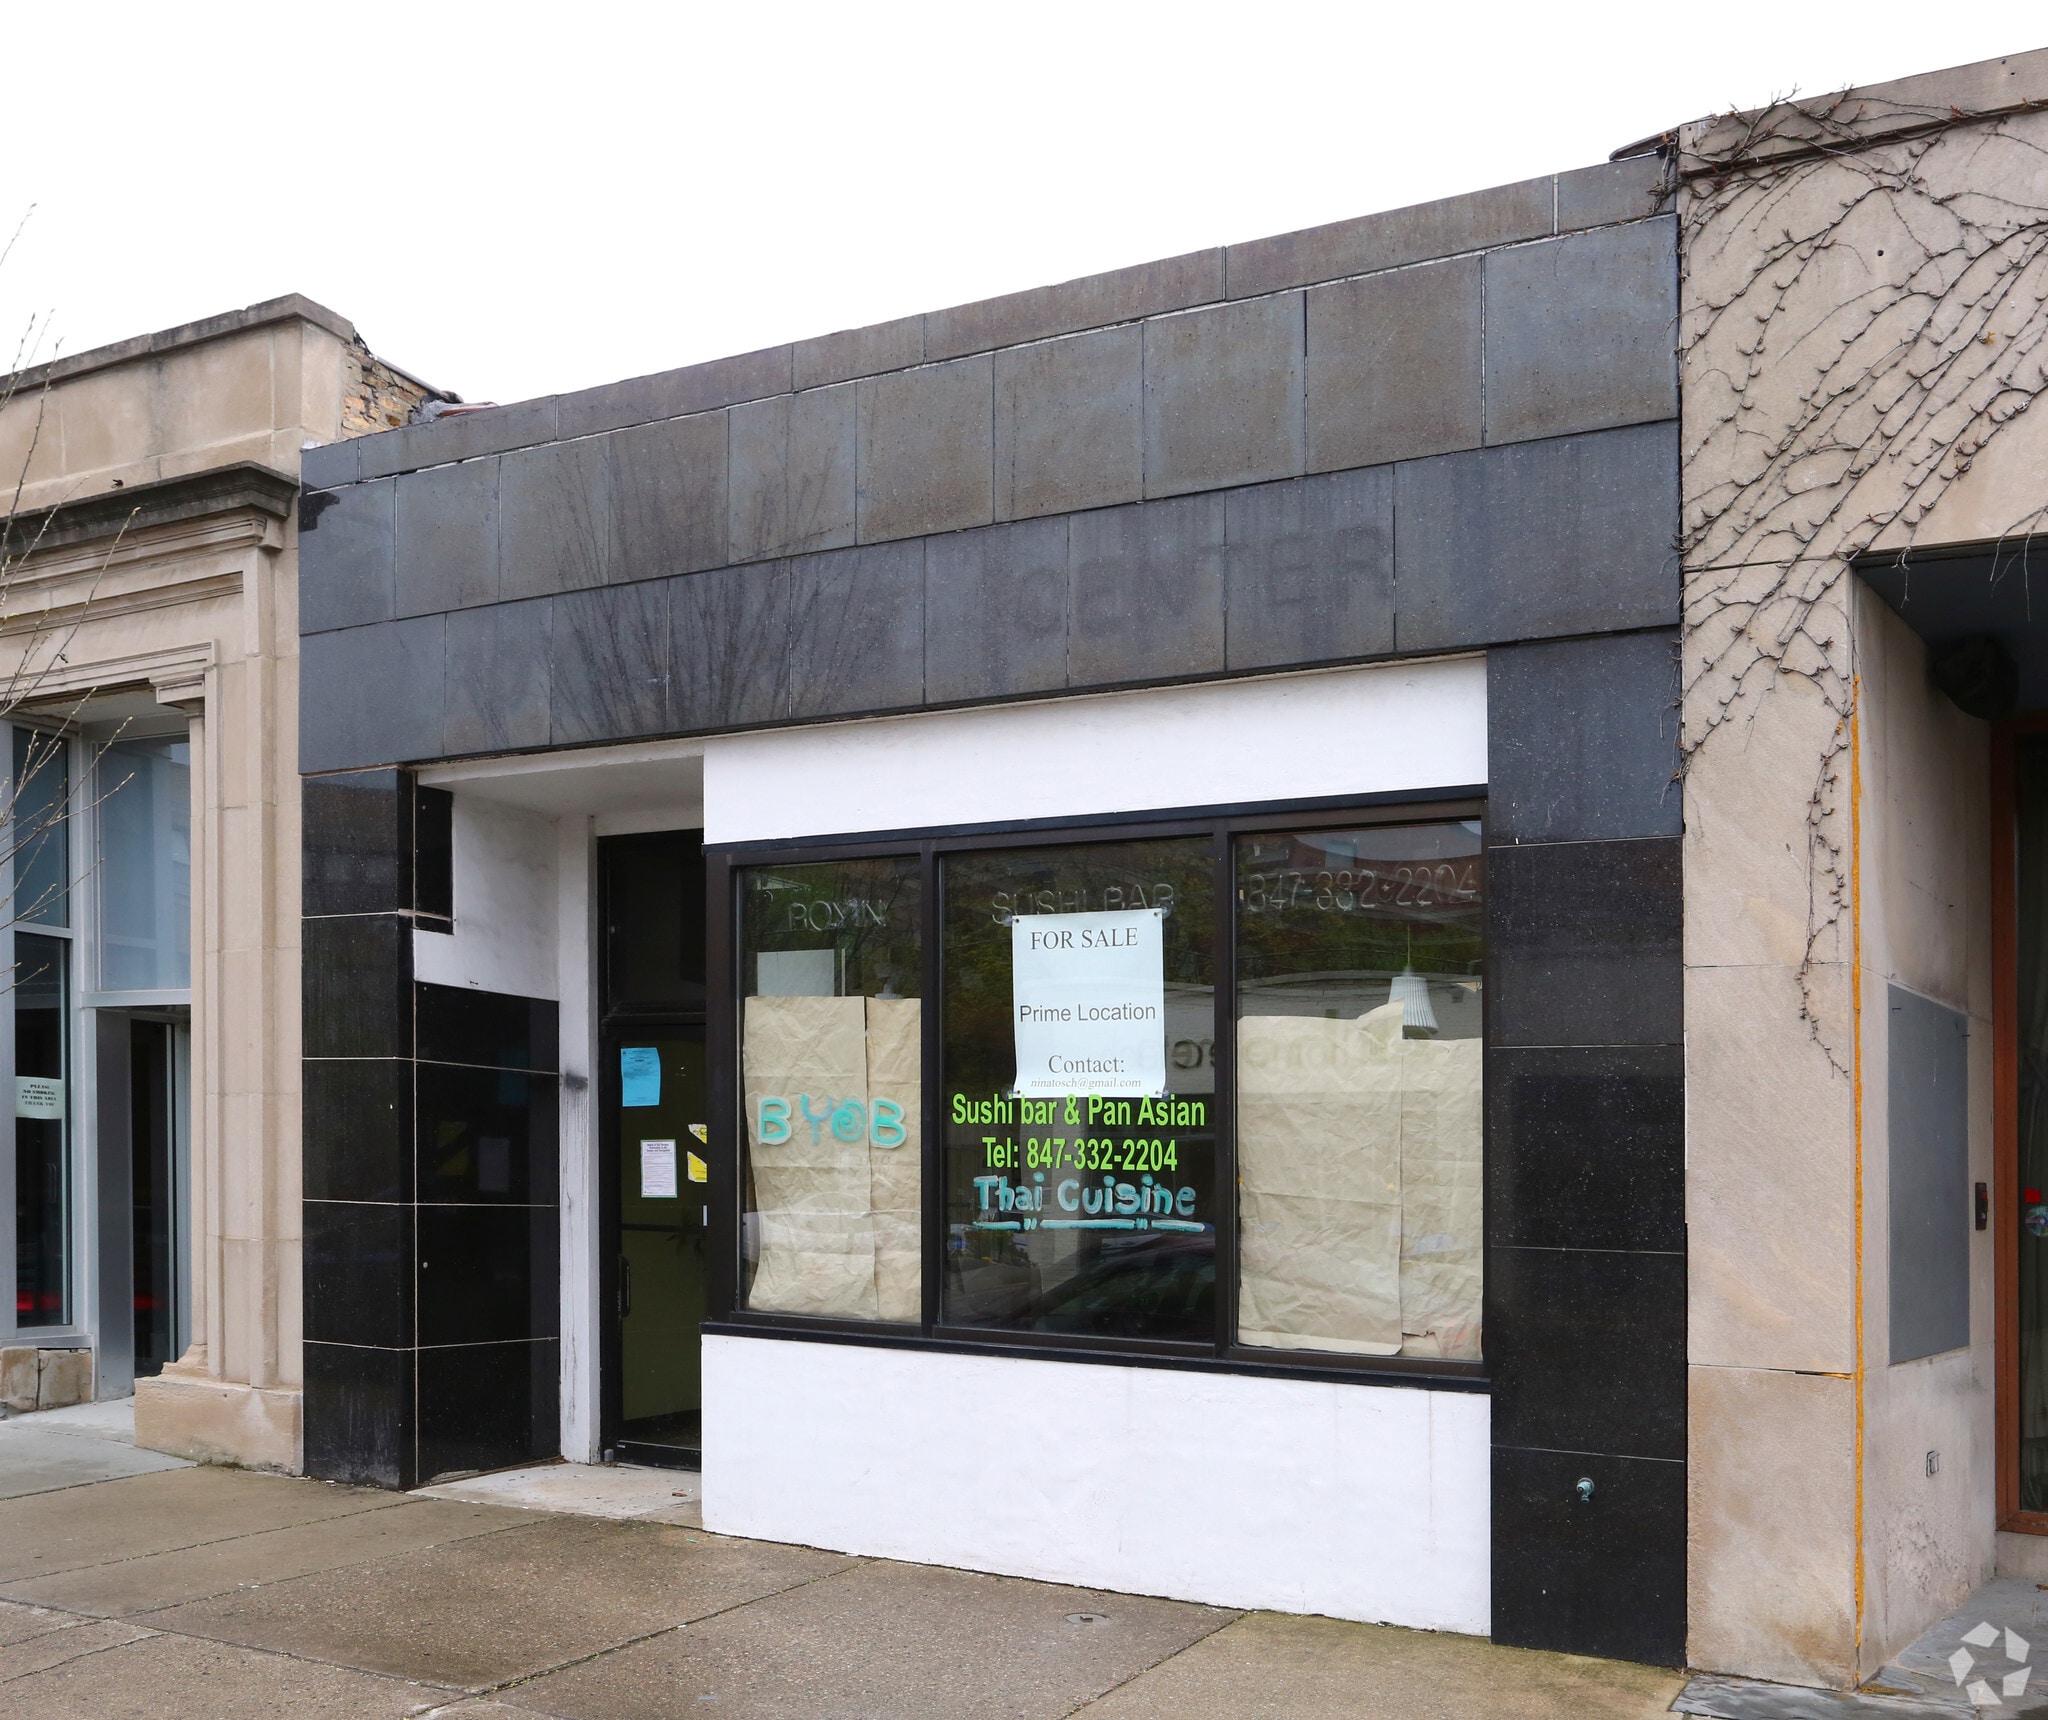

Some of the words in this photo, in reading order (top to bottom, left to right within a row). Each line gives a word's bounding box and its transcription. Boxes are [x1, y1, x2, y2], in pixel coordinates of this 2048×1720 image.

[1014, 524, 1392, 641] CENTER
[992, 889, 1087, 926] SUSHI
[1031, 931, 1074, 950] FOR
[1081, 927, 1138, 948] SALE
[1020, 1005, 1071, 1022] Prime
[1078, 1003, 1156, 1021] Location
[1048, 1055, 1125, 1074] Contact:
[1030, 1077, 1141, 1090] ninatosch@gmail.com
[757, 1093, 908, 1150] BYOB
[952, 1093, 1014, 1127] Sushi
[1021, 1094, 1058, 1126] bar
[1065, 1094, 1081, 1126] &
[1087, 1095, 1132, 1127] Pan
[1137, 1093, 1205, 1127] Asian
[982, 1136, 1020, 1170] Tel:
[1026, 1137, 1177, 1172] 847-332-2204
[973, 1171, 1045, 1213] Thai
[1057, 1170, 1197, 1216] Cuisine
